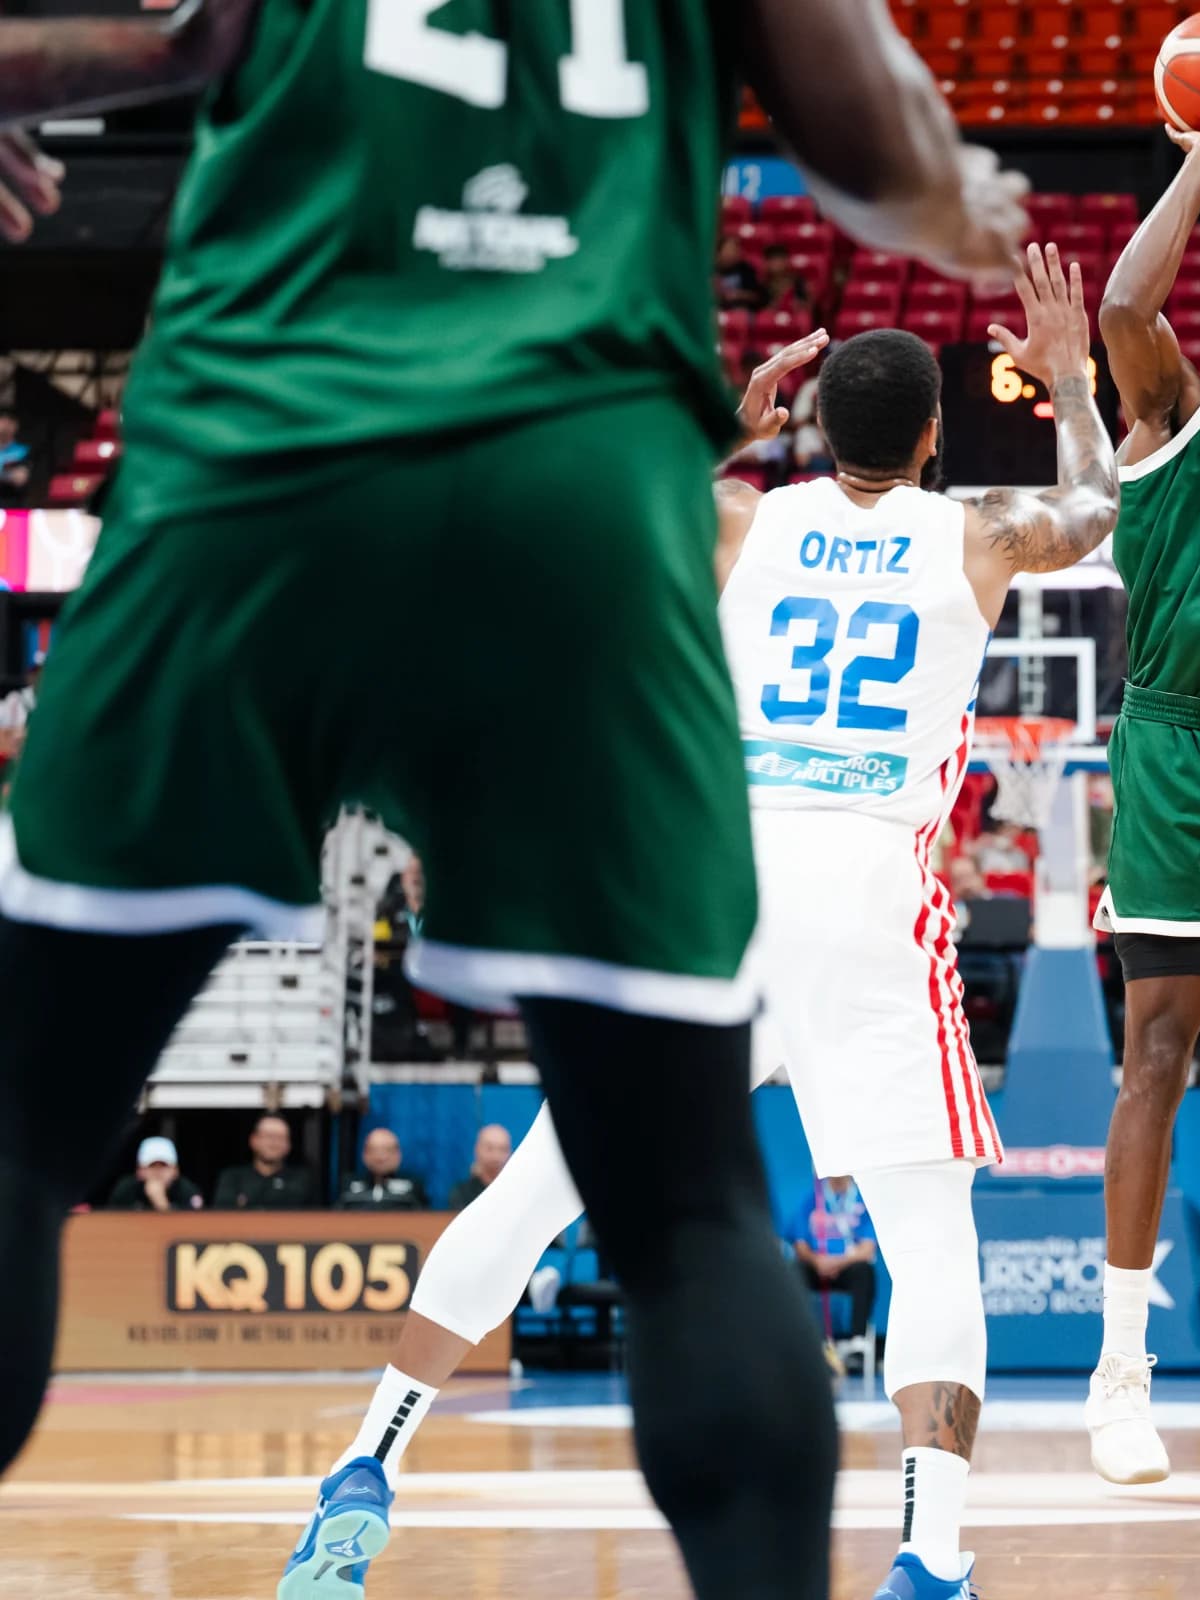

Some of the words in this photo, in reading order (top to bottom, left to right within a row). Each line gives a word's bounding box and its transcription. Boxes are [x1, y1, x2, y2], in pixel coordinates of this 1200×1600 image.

[799, 530, 912, 575] ORTIZ
[760, 596, 920, 733] 32
[174, 1243, 268, 1312] KQ
[276, 1242, 410, 1311] 105
